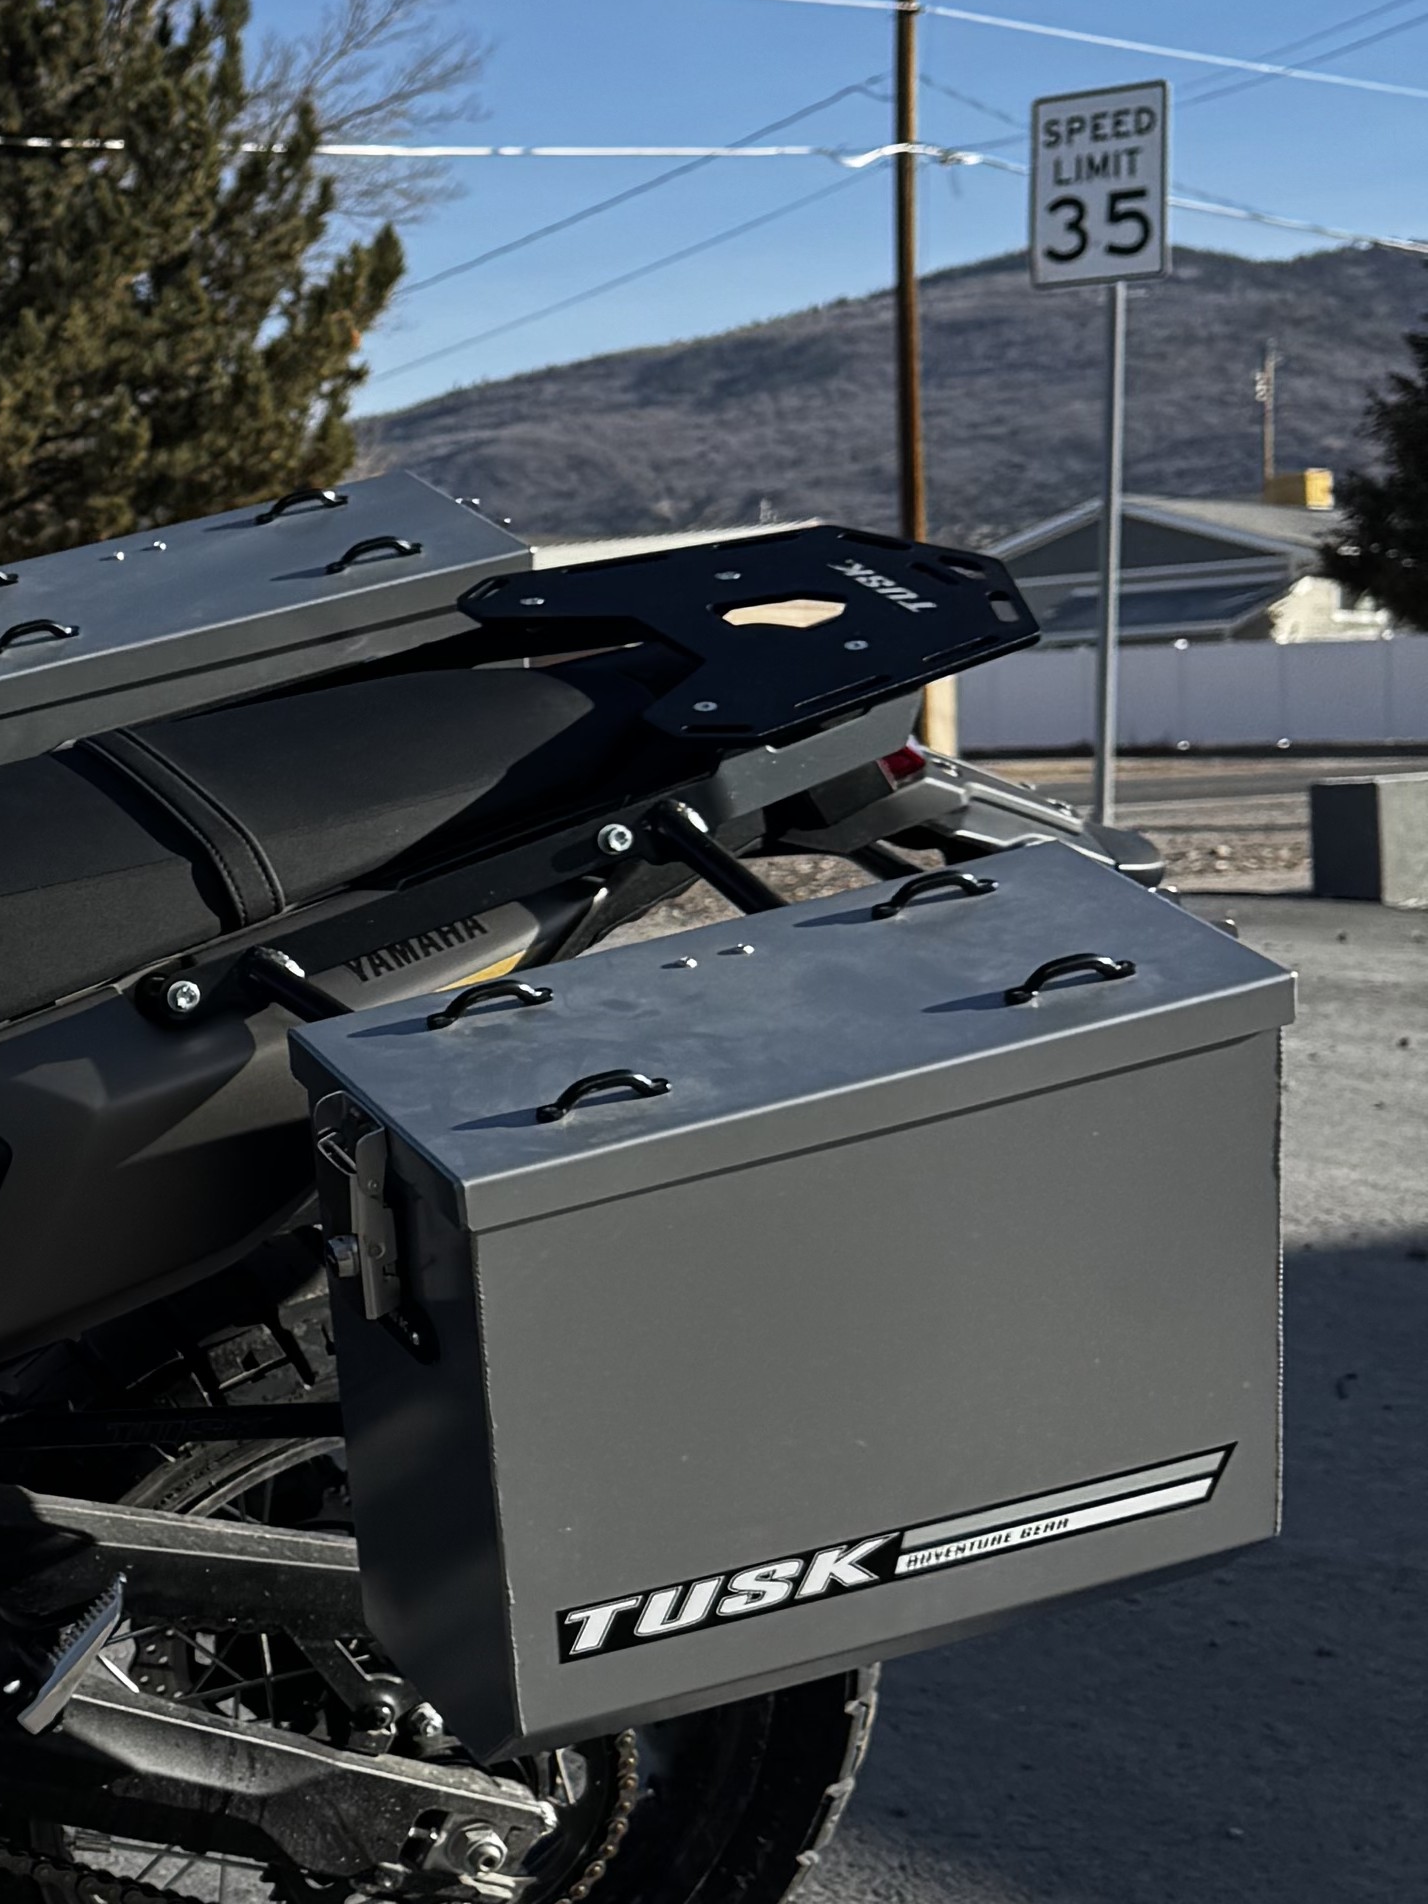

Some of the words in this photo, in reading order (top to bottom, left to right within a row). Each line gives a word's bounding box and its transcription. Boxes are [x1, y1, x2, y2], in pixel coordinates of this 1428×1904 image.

[1043, 106, 1157, 148] SPEED
[1053, 147, 1142, 186] LIMIT
[1045, 188, 1153, 263] 35
[826, 558, 938, 613] TUSK
[343, 915, 488, 982] YAMAHA
[564, 1532, 901, 1655] TUSK
